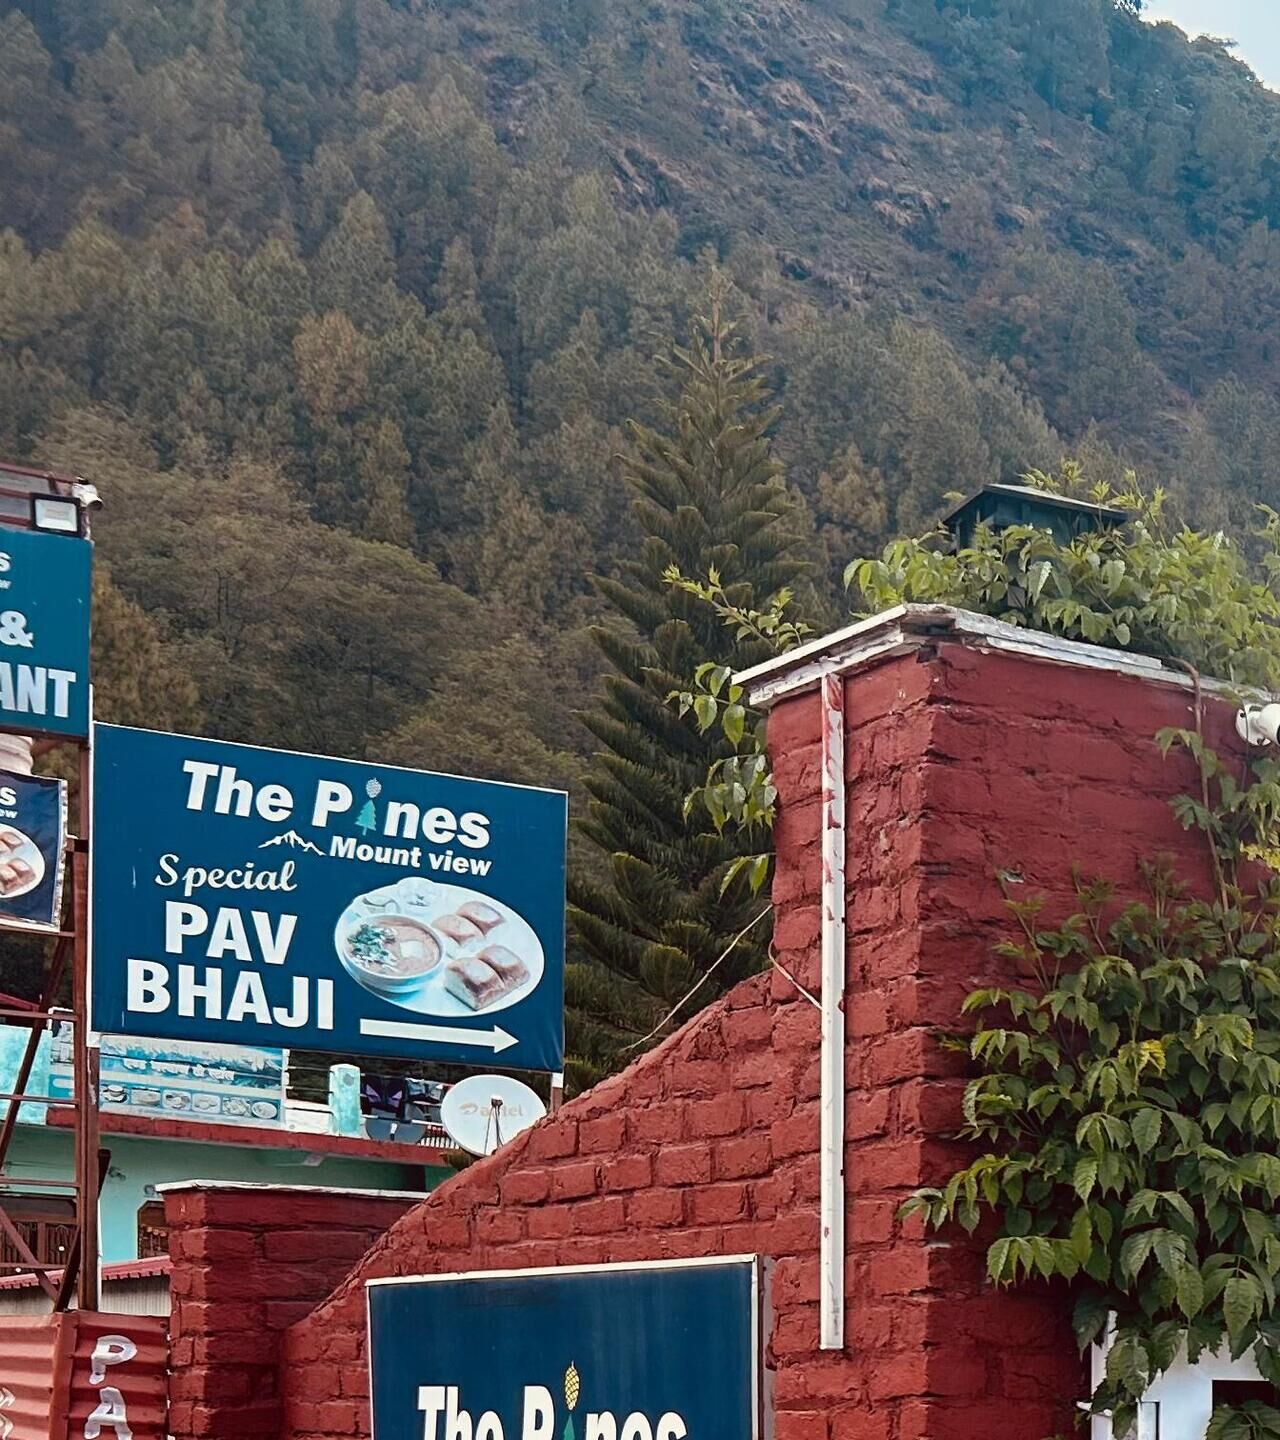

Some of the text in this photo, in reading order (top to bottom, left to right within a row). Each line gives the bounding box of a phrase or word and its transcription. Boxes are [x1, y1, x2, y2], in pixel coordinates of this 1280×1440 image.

[183, 759, 294, 822] The
[154, 852, 298, 897] Special
[329, 835, 492, 877] Mount view
[165, 900, 298, 965] PAV
[127, 958, 334, 1030] BHAJI
